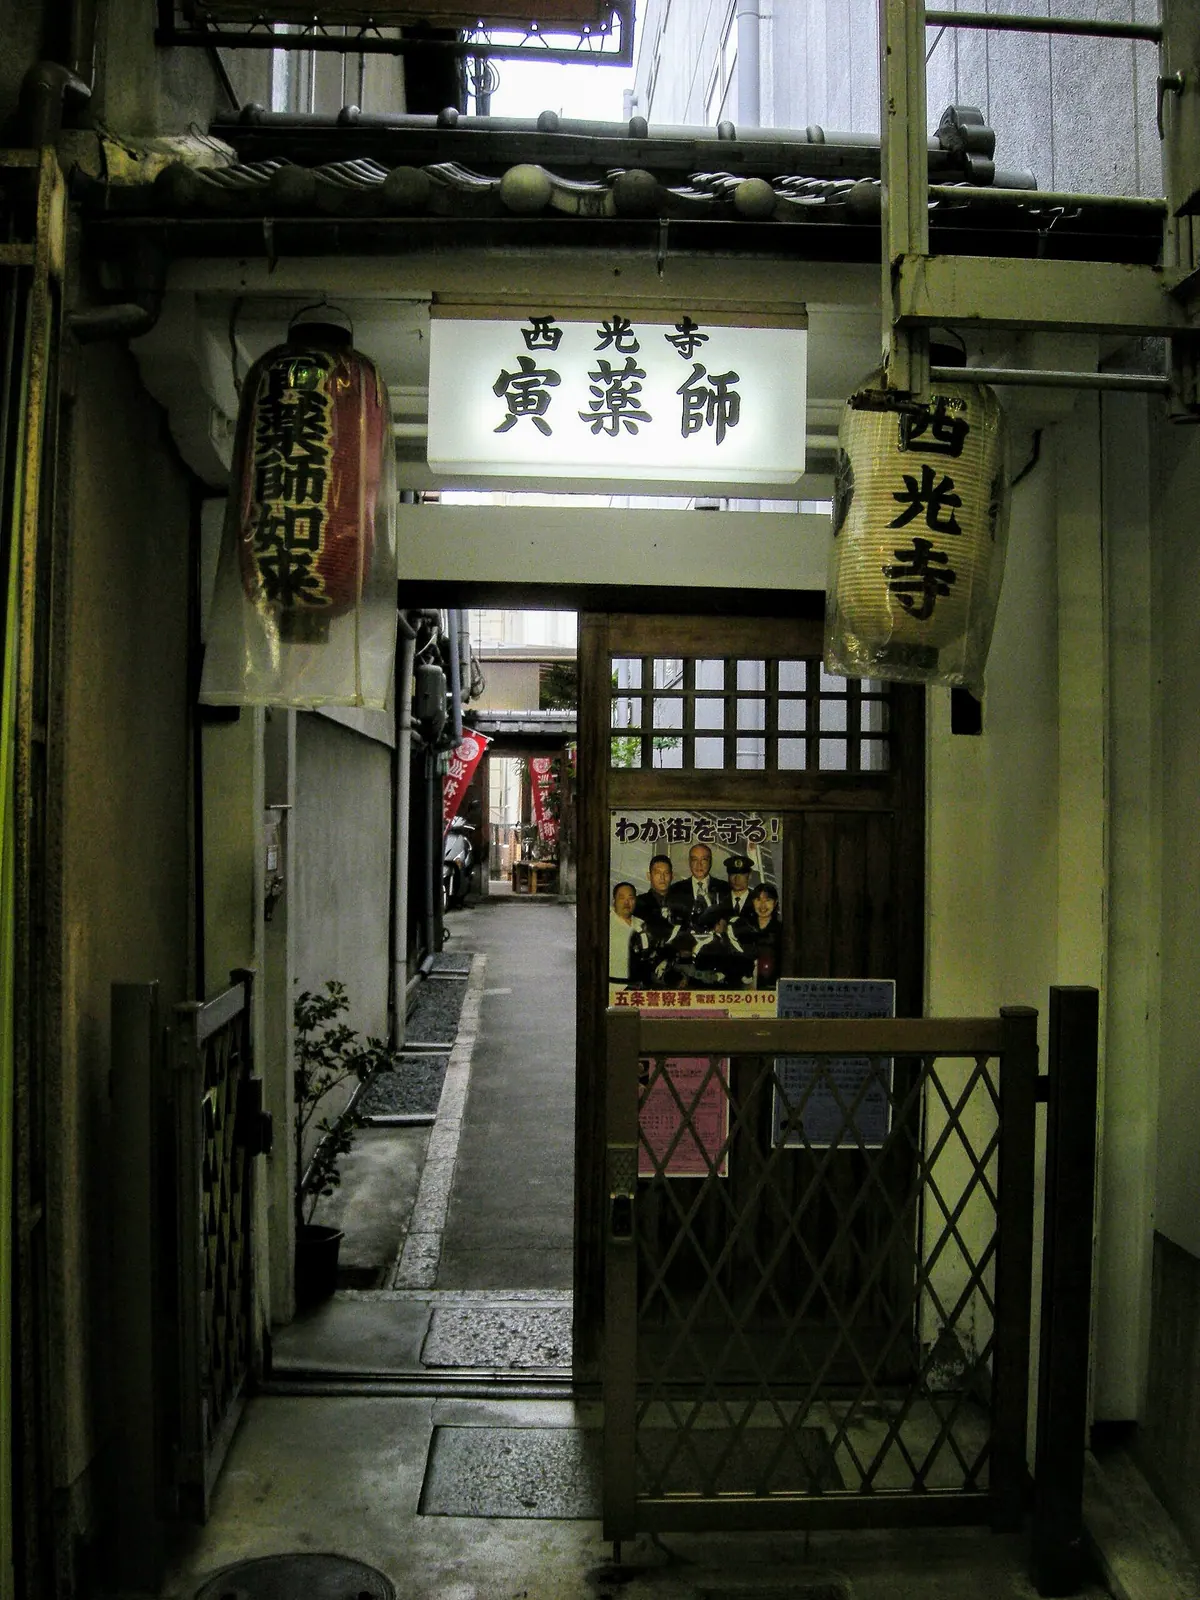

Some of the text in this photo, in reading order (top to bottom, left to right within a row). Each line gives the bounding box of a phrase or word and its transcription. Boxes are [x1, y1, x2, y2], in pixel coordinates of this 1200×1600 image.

[520, 314, 710, 359] 西光寺
[492, 356, 742, 446] 寅薬師
[882, 394, 970, 621] 西光寺
[614, 816, 780, 844] わが街を守る!
[614, 991, 692, 1007] 五条警察署
[696, 994, 716, 1005] 電話
[718, 994, 776, 1004] 352-0110
